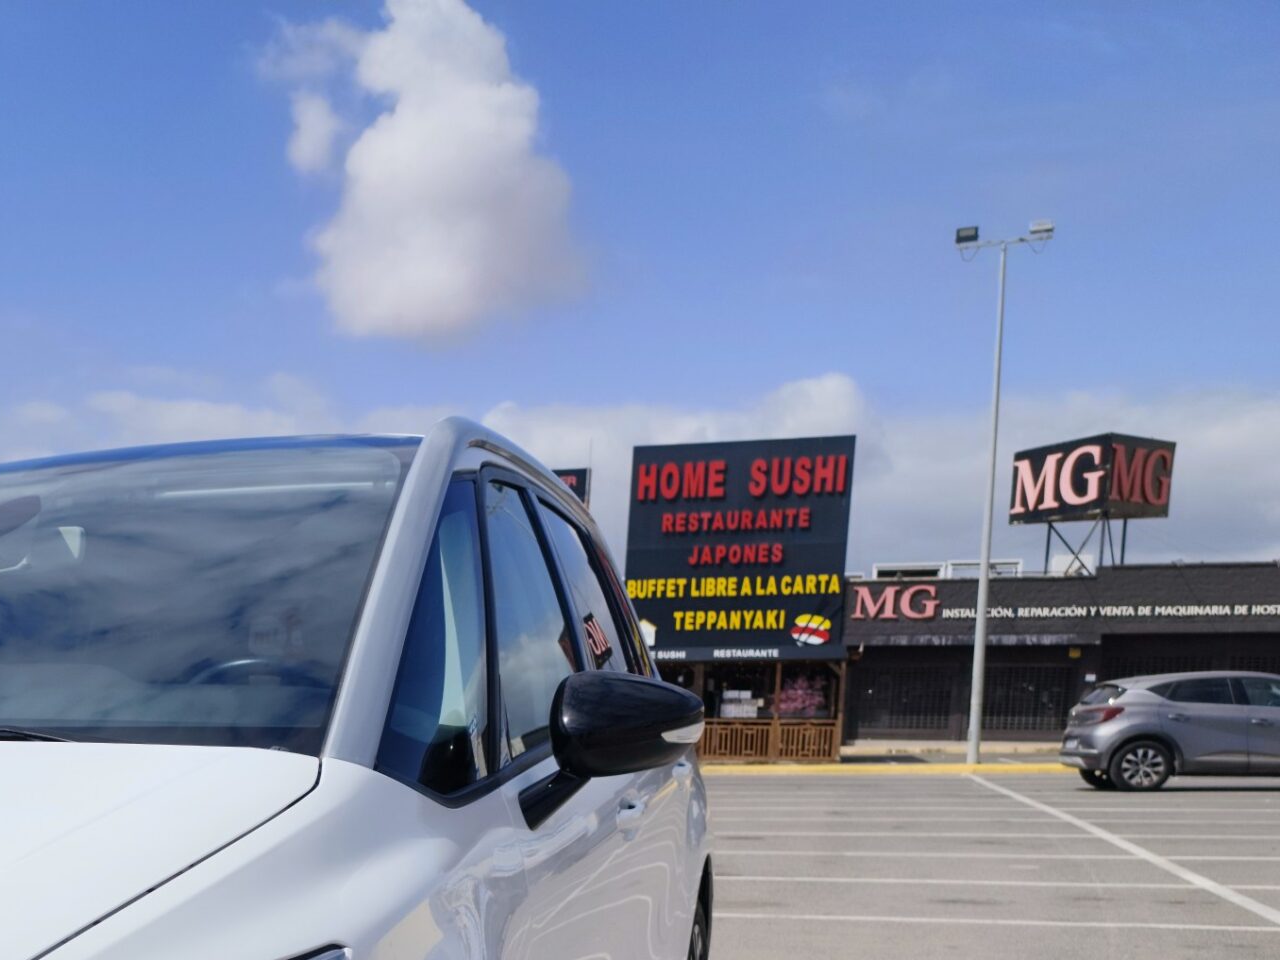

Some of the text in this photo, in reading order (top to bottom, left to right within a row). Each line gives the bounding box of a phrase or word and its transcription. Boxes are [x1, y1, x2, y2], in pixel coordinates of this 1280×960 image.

[637, 456, 847, 500] HOME SUSHI
[1010, 445, 1105, 514] MG
[1109, 443, 1171, 505] MG
[662, 509, 810, 532] RESTAURANTE
[688, 544, 783, 565] JAPONES
[626, 574, 841, 600] BUFFET LIBRE A LA CARTA
[851, 585, 940, 619] MG
[942, 607, 1015, 619] INSTALCIÓN,
[1017, 604, 1087, 618] REPARACIÓN
[1089, 606, 1099, 617] Y
[1099, 606, 1135, 616] VENTA
[1138, 606, 1152, 616] DE
[1154, 605, 1231, 618] MAQUINARIA
[1234, 605, 1248, 615] DE
[673, 609, 786, 631] TEPPANYAKI
[657, 651, 686, 660] SUSHI
[713, 649, 780, 659] RESTAURANTE
